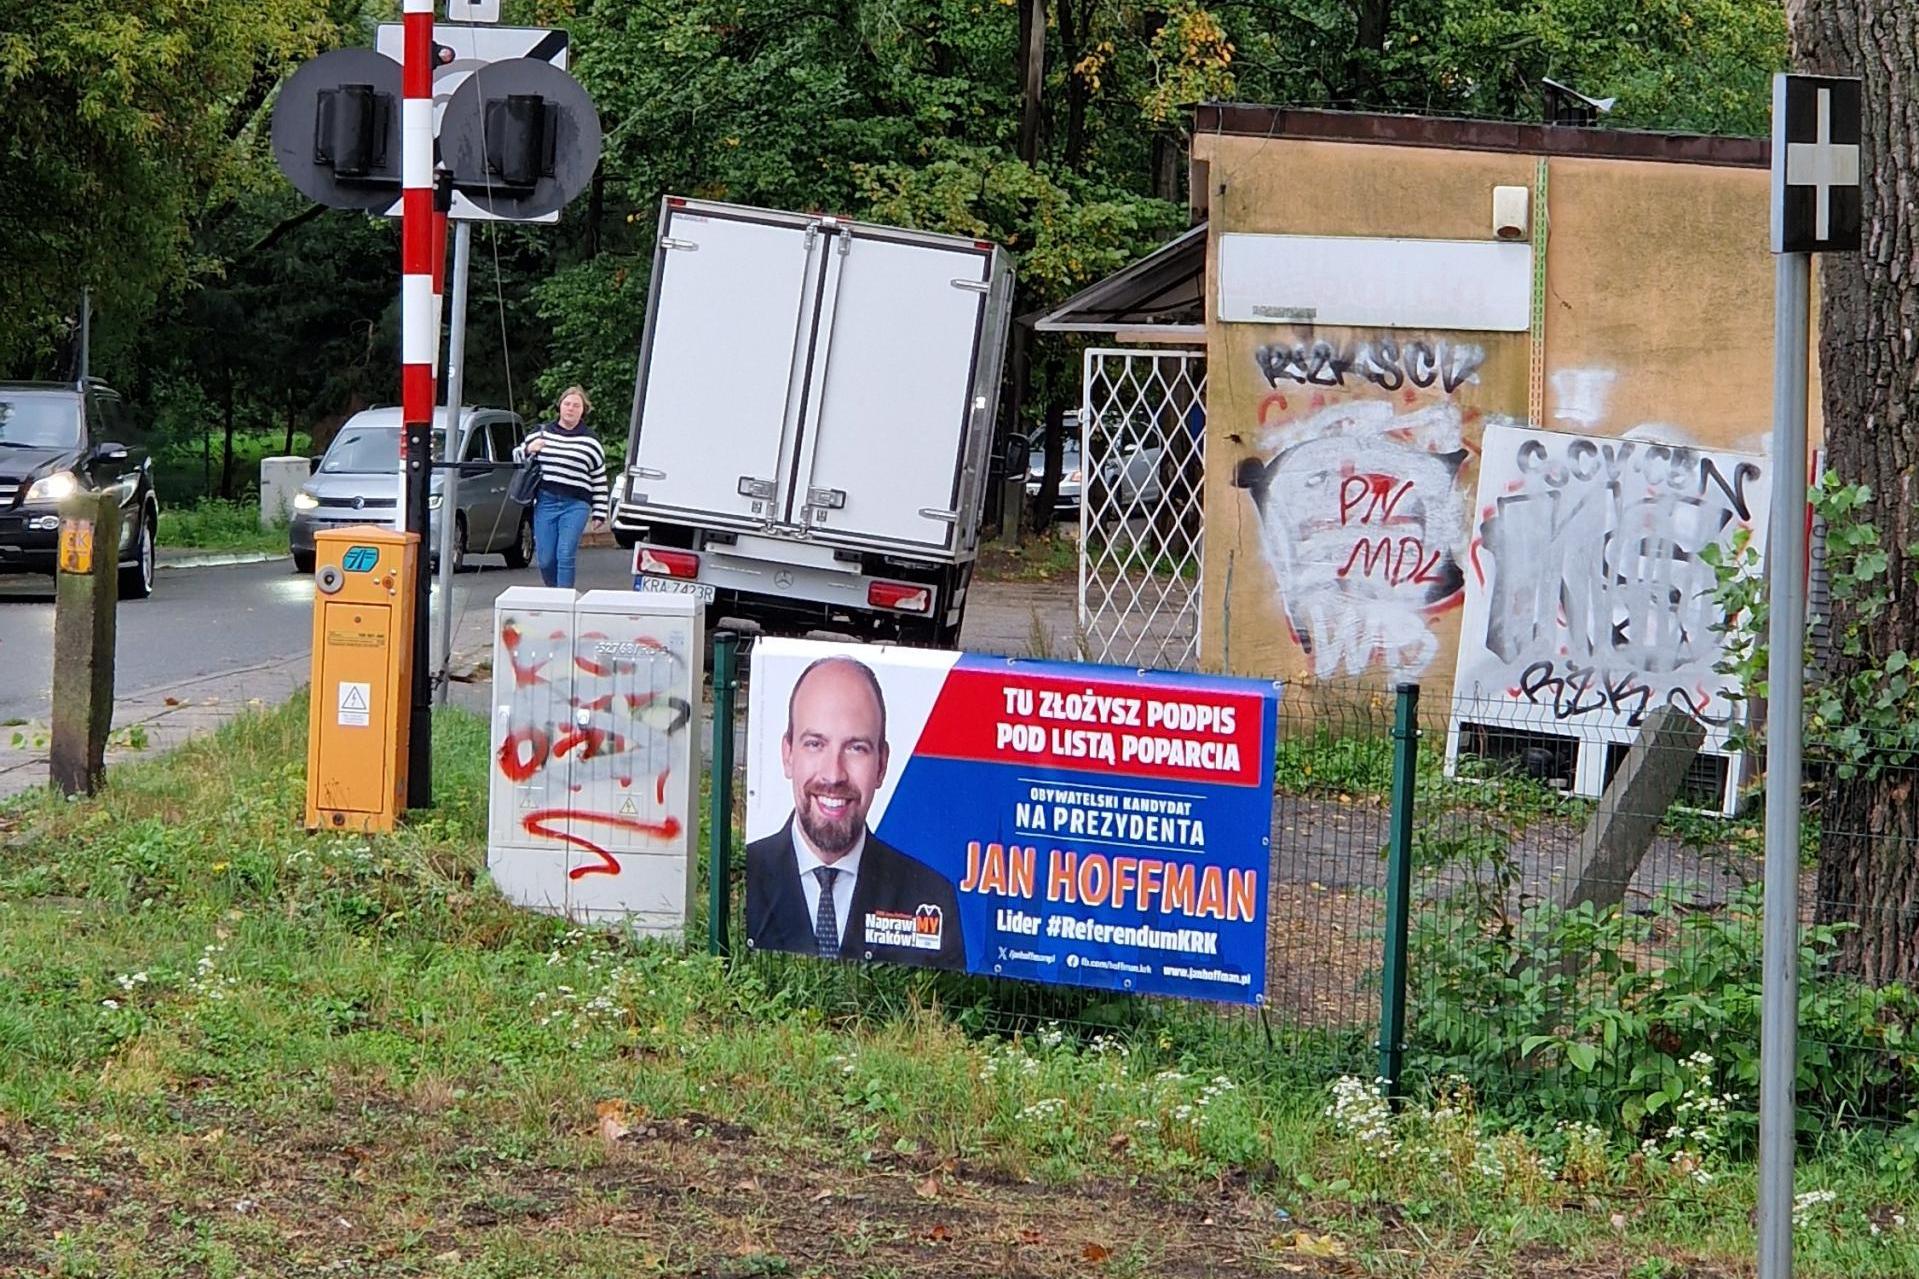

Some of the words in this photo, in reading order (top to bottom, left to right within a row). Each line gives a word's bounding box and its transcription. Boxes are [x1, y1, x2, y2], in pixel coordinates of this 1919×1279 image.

[642, 577, 667, 593] KRA
[672, 582, 713, 600] 7423R
[1003, 686, 1034, 716] TU
[1038, 688, 1142, 728] ZŁOŻYSZ
[1146, 699, 1237, 735] PODPIS
[996, 722, 1046, 753] POD
[1051, 728, 1117, 766] LISTĄ
[1121, 734, 1241, 772] POPARCIA
[1015, 802, 1047, 831] NA
[1052, 806, 1206, 847] PREZYDENTA
[1030, 787, 1120, 810] OBYWATELSKI
[1122, 796, 1193, 816] KANDYDAT
[960, 840, 1037, 899] JAN
[1046, 848, 1258, 923] HOFFMAN
[865, 927, 917, 948] Kraków!
[996, 908, 1042, 937] Lider
[1047, 914, 1219, 956] #ReferendumKRK
